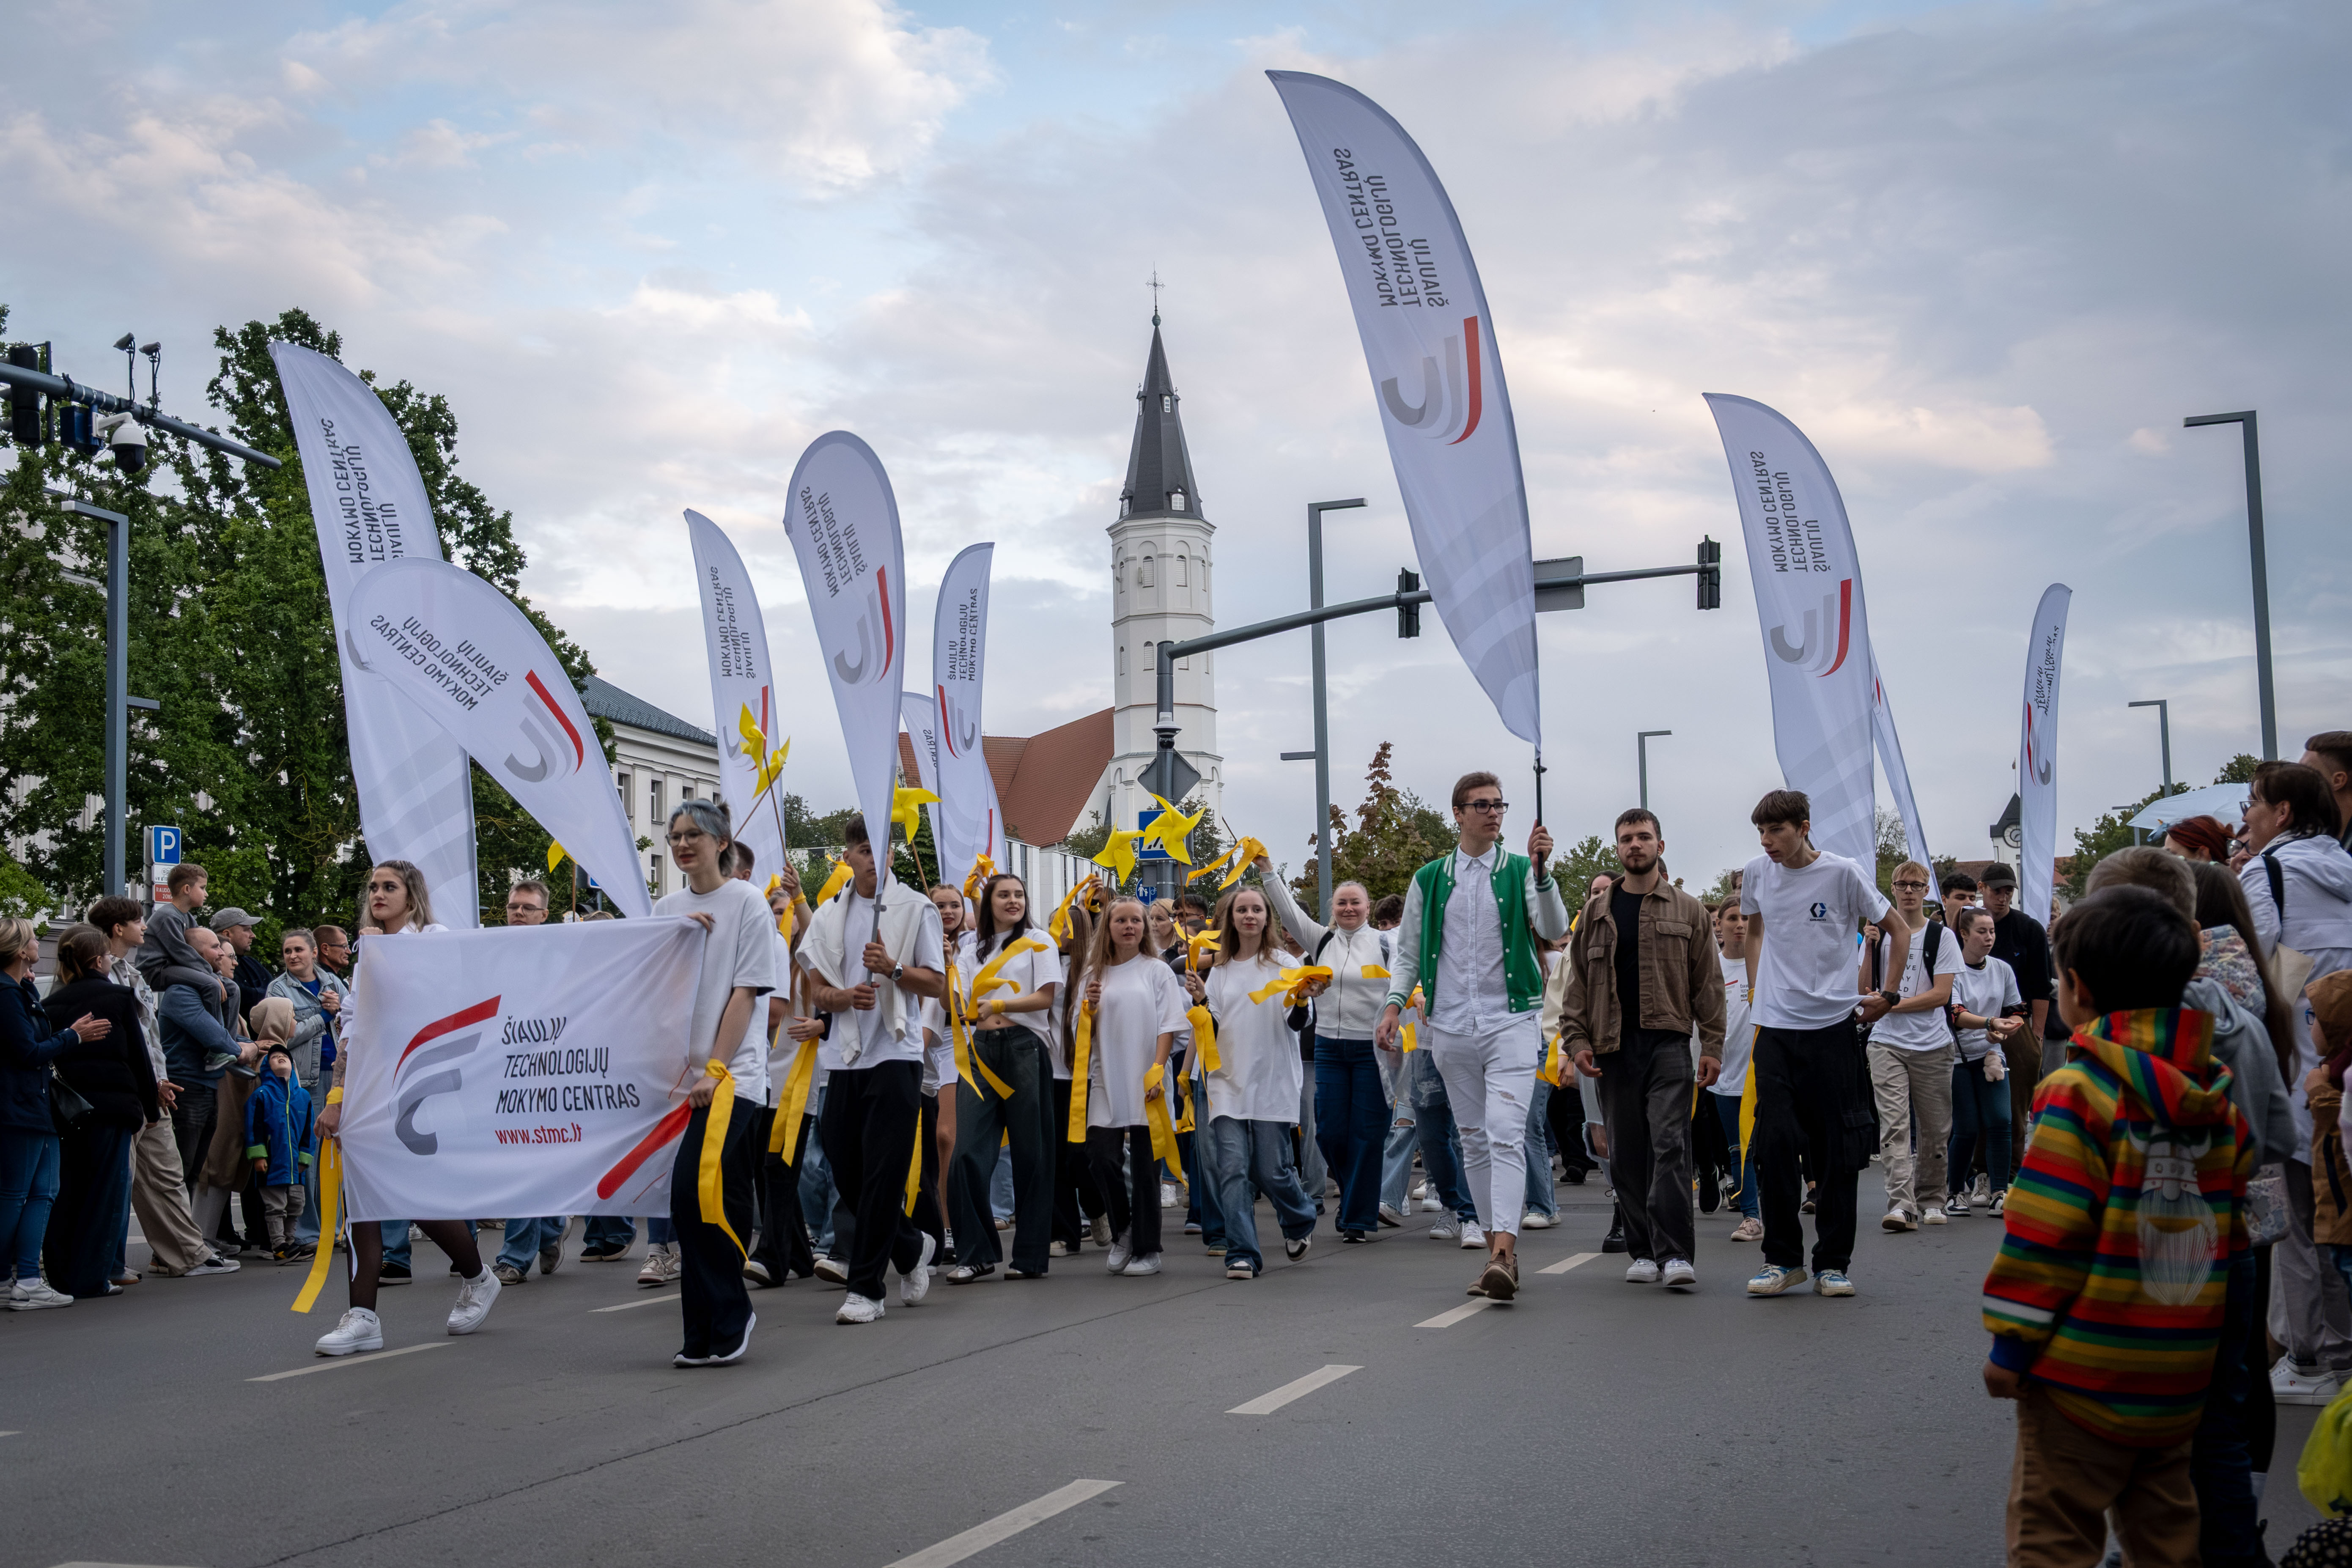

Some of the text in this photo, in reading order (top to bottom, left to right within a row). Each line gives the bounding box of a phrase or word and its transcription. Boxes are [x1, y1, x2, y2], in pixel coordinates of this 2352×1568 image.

[959, 604, 969, 680] TECHNOLOGIJŲ
[968, 588, 978, 681] MOKYMO CENTRAS
[948, 641, 959, 680] ŠIAULIŲ
[161, 831, 176, 860] P
[502, 1015, 566, 1045] ŠIAULIŲ
[504, 1047, 609, 1078] TECHNOLOGIJŲ
[496, 1083, 640, 1113] MOKYMO CENTRAS
[495, 1122, 582, 1144] www.stmc.lt
